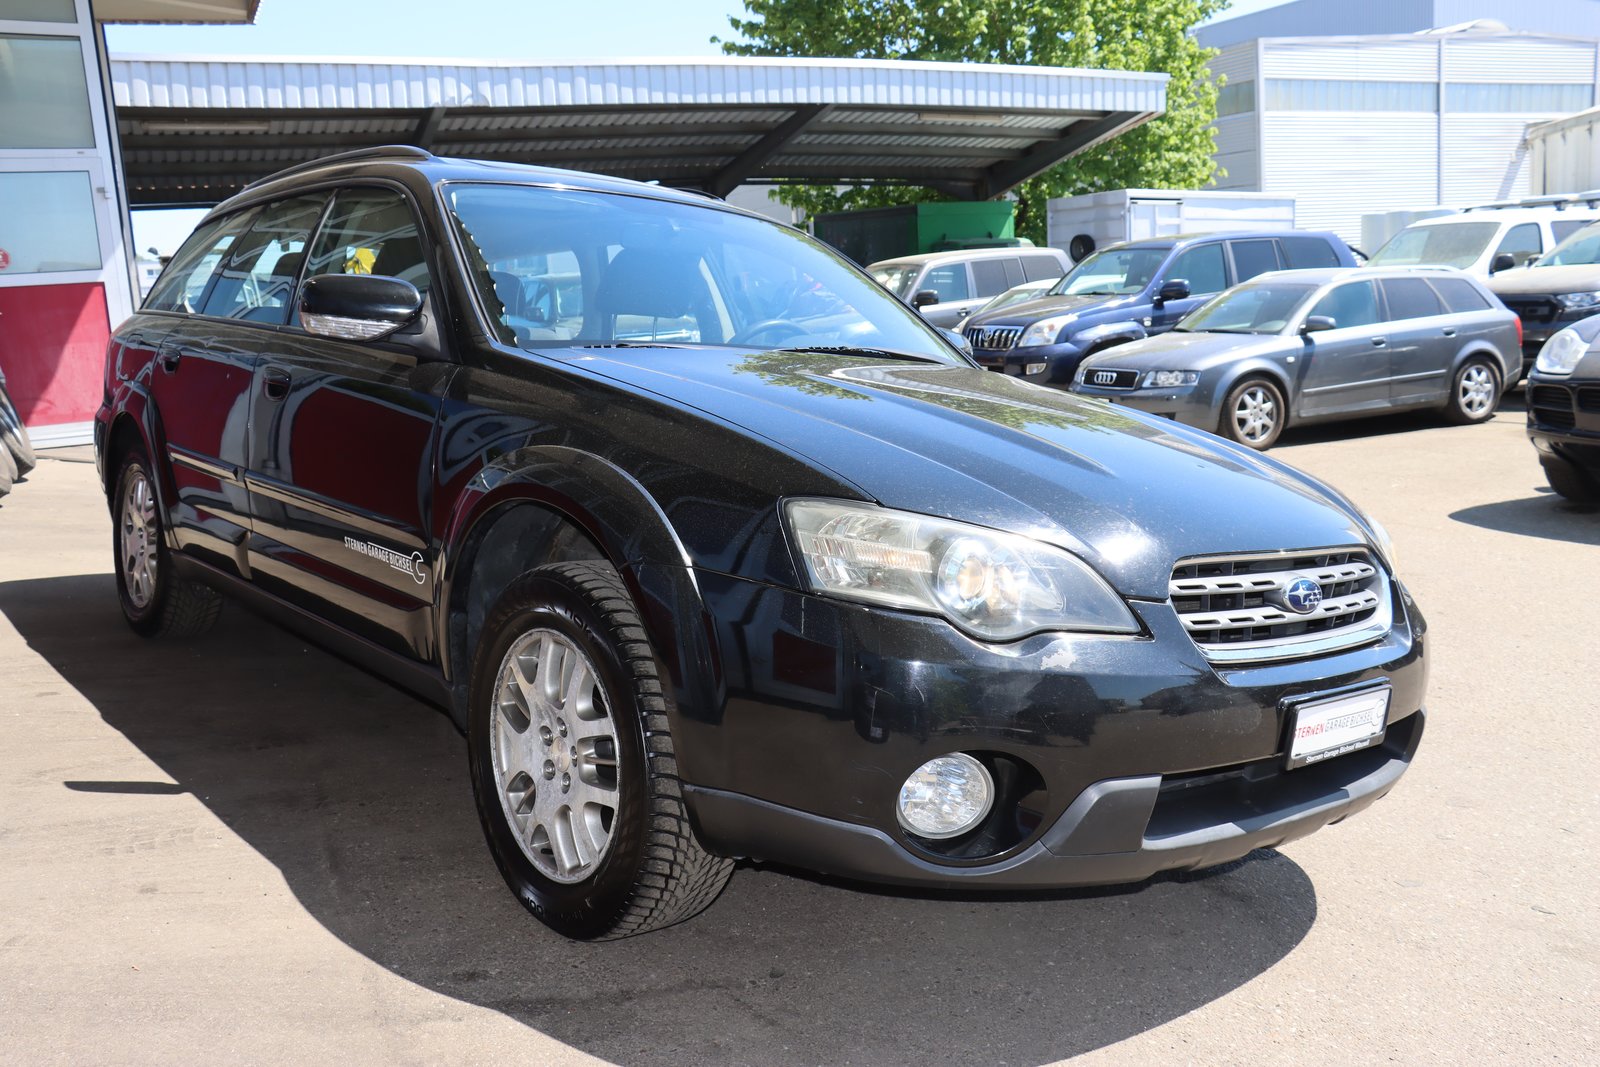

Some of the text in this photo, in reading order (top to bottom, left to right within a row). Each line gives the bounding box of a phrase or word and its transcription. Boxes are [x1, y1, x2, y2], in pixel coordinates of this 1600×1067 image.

[344, 536, 413, 572] STERNEN GARAGE BICHSEL
[1294, 711, 1373, 739] STERNEN GARAGE BICHSEL
